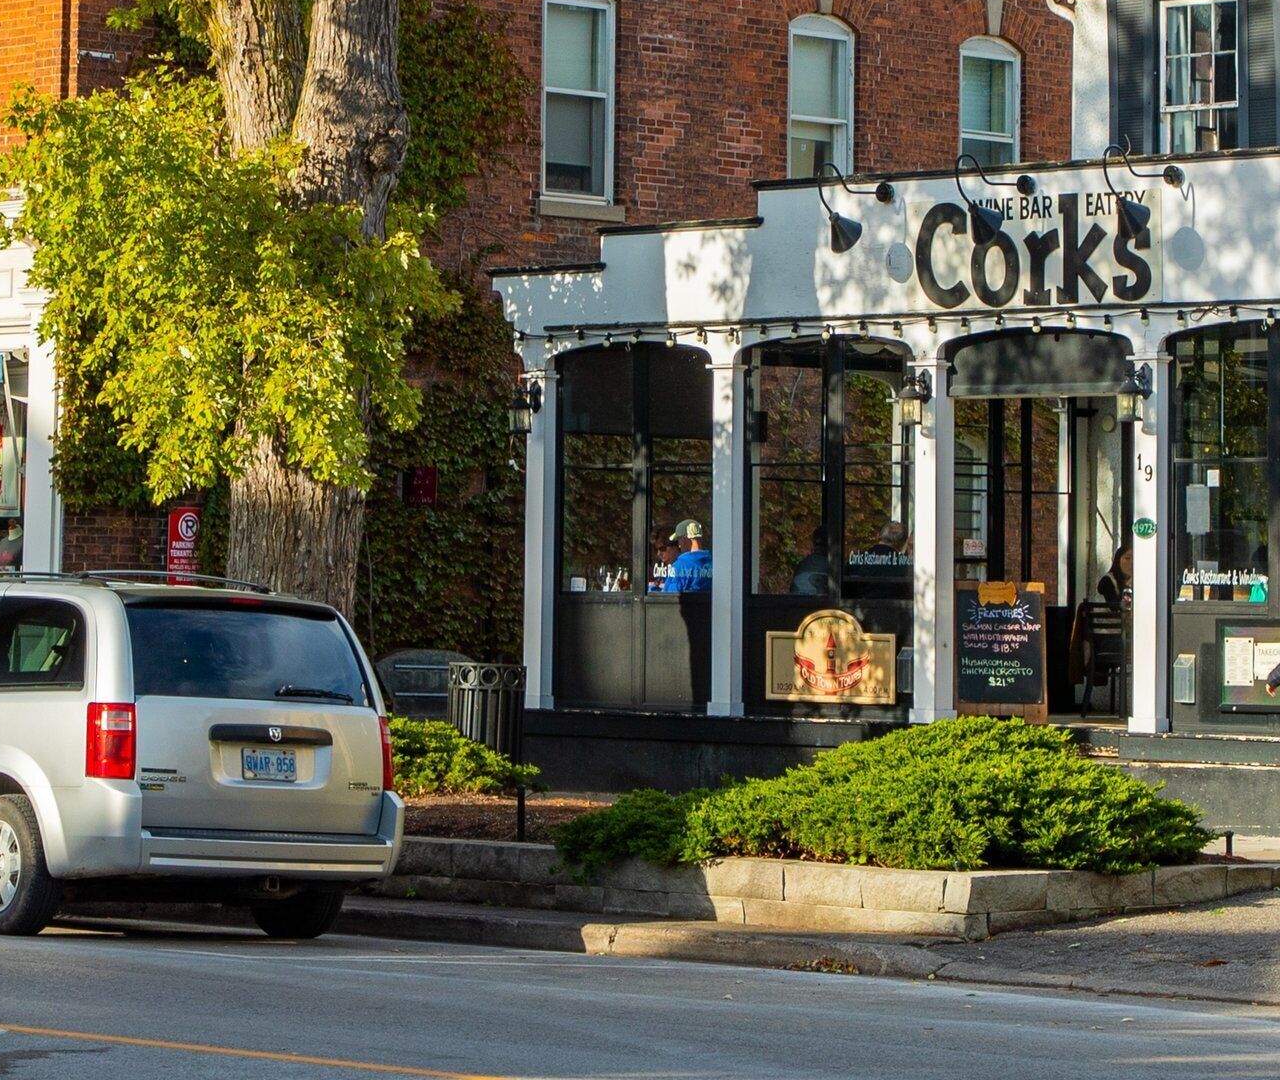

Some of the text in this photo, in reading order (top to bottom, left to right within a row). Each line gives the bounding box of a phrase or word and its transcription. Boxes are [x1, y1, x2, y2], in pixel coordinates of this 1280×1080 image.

[1020, 195, 1053, 219] BAR
[915, 193, 1152, 309] Corks
[1136, 453, 1153, 482] 19
[1134, 524, 1153, 534] 1972
[1200, 569, 1231, 585] Restaurant
[977, 607, 1024, 619] FEATURES
[1003, 659, 1020, 667] AND
[801, 668, 817, 685] OLD
[838, 670, 862, 687] TOURS
[276, 757, 296, 773] 858
